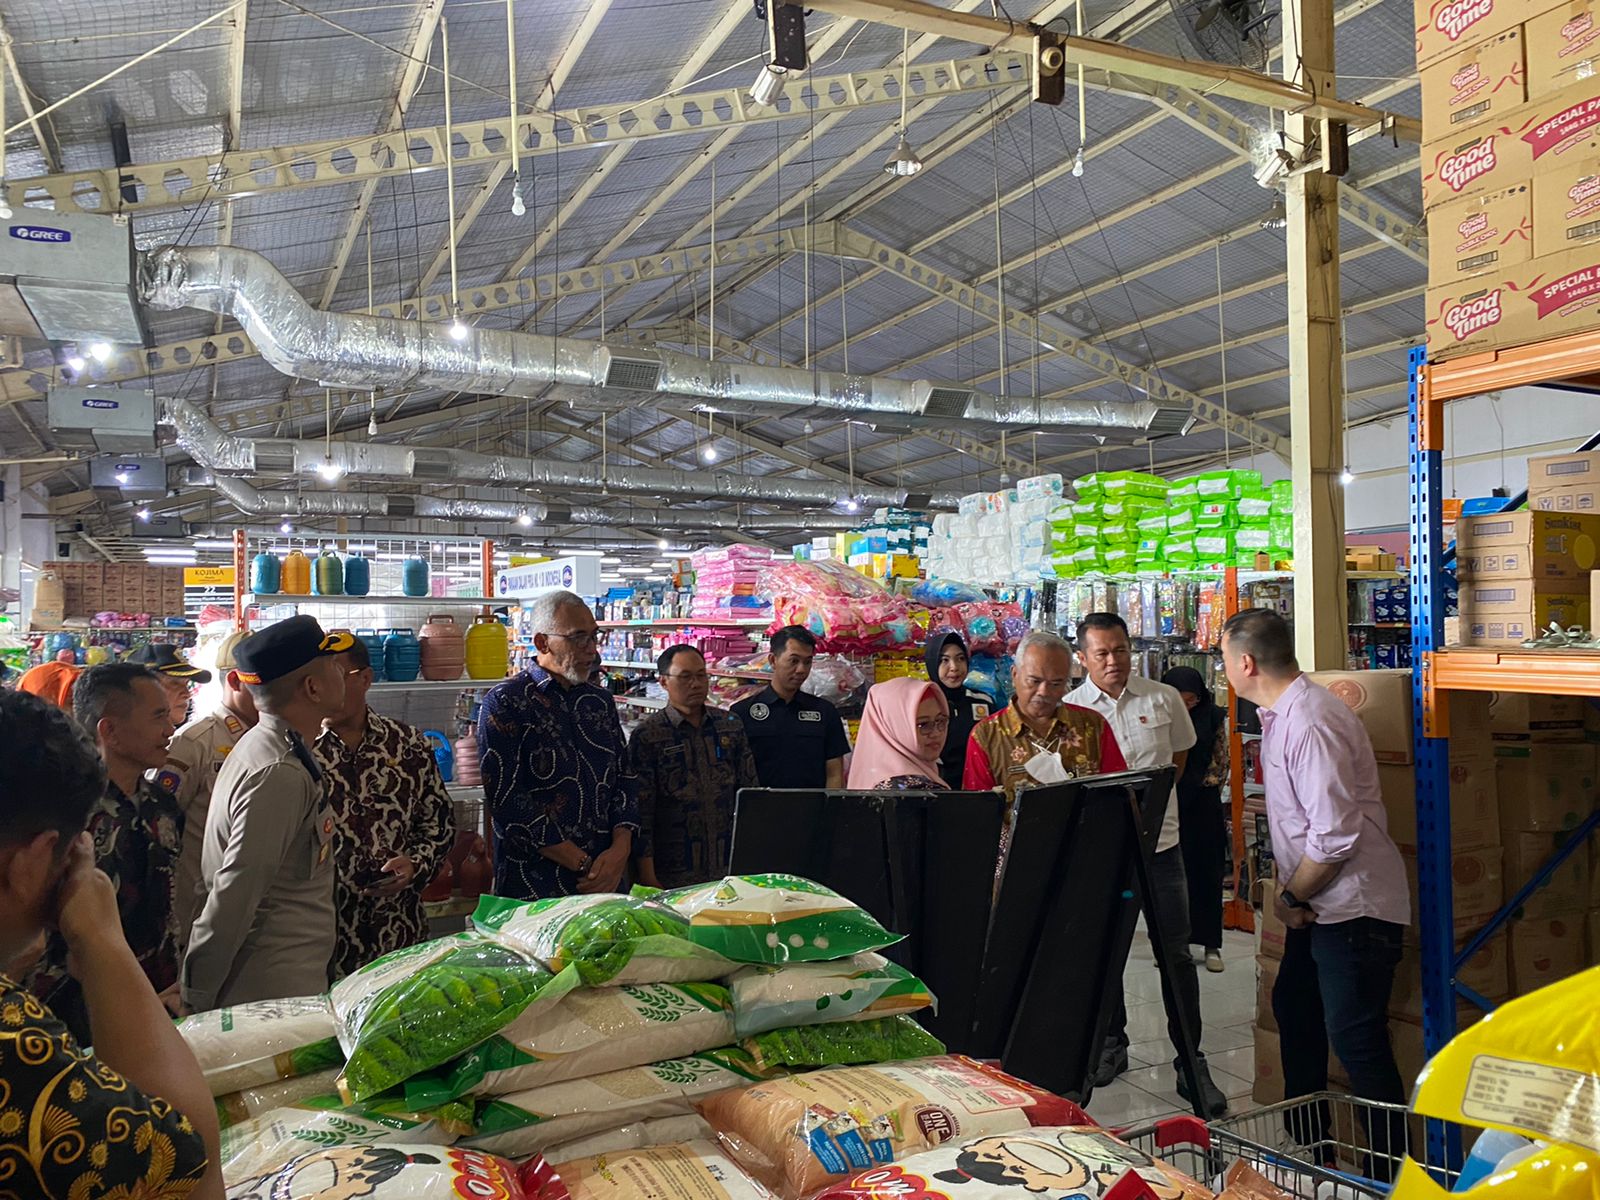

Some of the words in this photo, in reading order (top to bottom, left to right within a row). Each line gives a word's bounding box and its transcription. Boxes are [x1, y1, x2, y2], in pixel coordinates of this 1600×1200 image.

[1437, 0, 1481, 29] Goo
[1445, 0, 1491, 38] Time
[1451, 63, 1479, 86] Good
[1535, 106, 1586, 138] SPECIAL
[1440, 136, 1493, 179] Good
[1447, 153, 1496, 190] Time
[1567, 176, 1600, 198] Good
[29, 230, 64, 241] GREE
[1458, 212, 1487, 233] Good
[1463, 221, 1487, 239] Time
[1543, 270, 1595, 299] SPECIAL
[1567, 286, 1588, 299] 144G
[1446, 290, 1499, 327] Good
[1453, 307, 1500, 338] Time
[204, 586, 216, 594] 22
[930, 1112, 950, 1134] ONE
